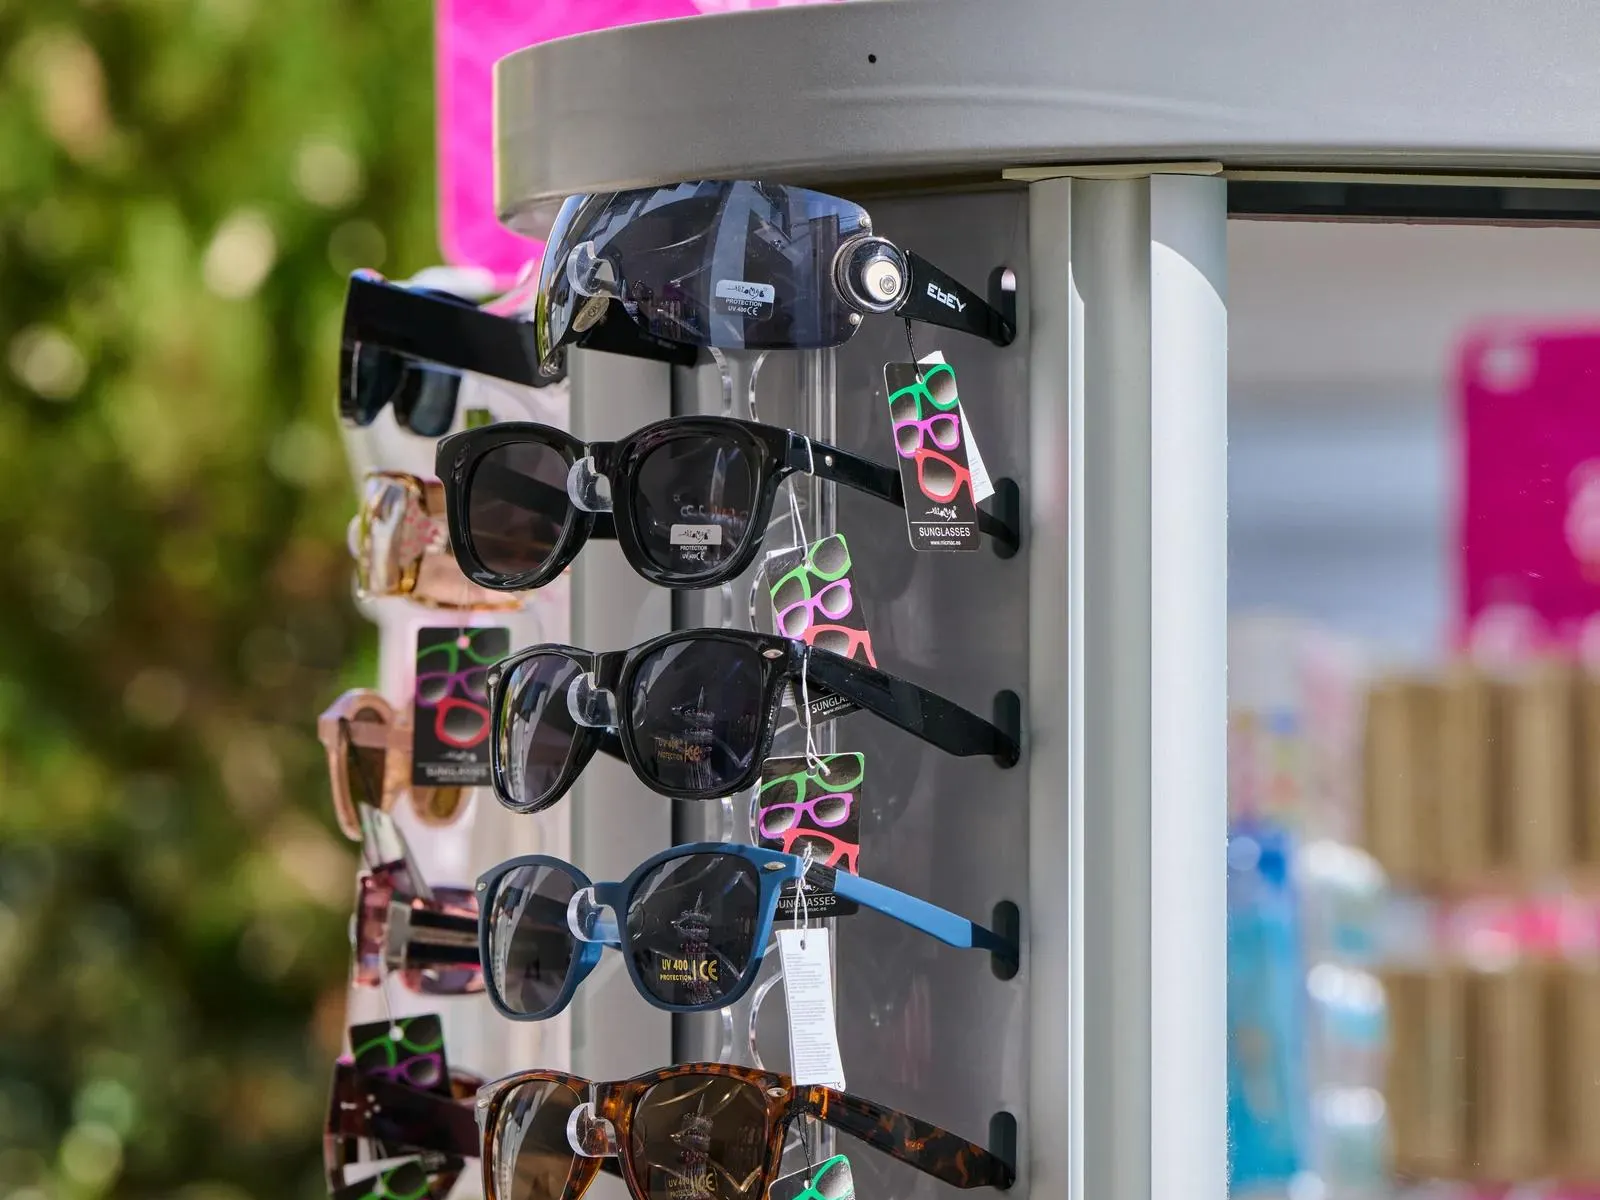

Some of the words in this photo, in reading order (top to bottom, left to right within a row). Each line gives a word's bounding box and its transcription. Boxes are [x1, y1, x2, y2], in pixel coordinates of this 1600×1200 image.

[726, 297, 762, 308] PROTECTION
[747, 306, 758, 316] CE
[919, 527, 971, 537] SUNGLASSES
[661, 959, 672, 970] UV
[673, 960, 688, 971] 400
[700, 960, 718, 981] CE
[660, 974, 692, 982] PROTECTION
